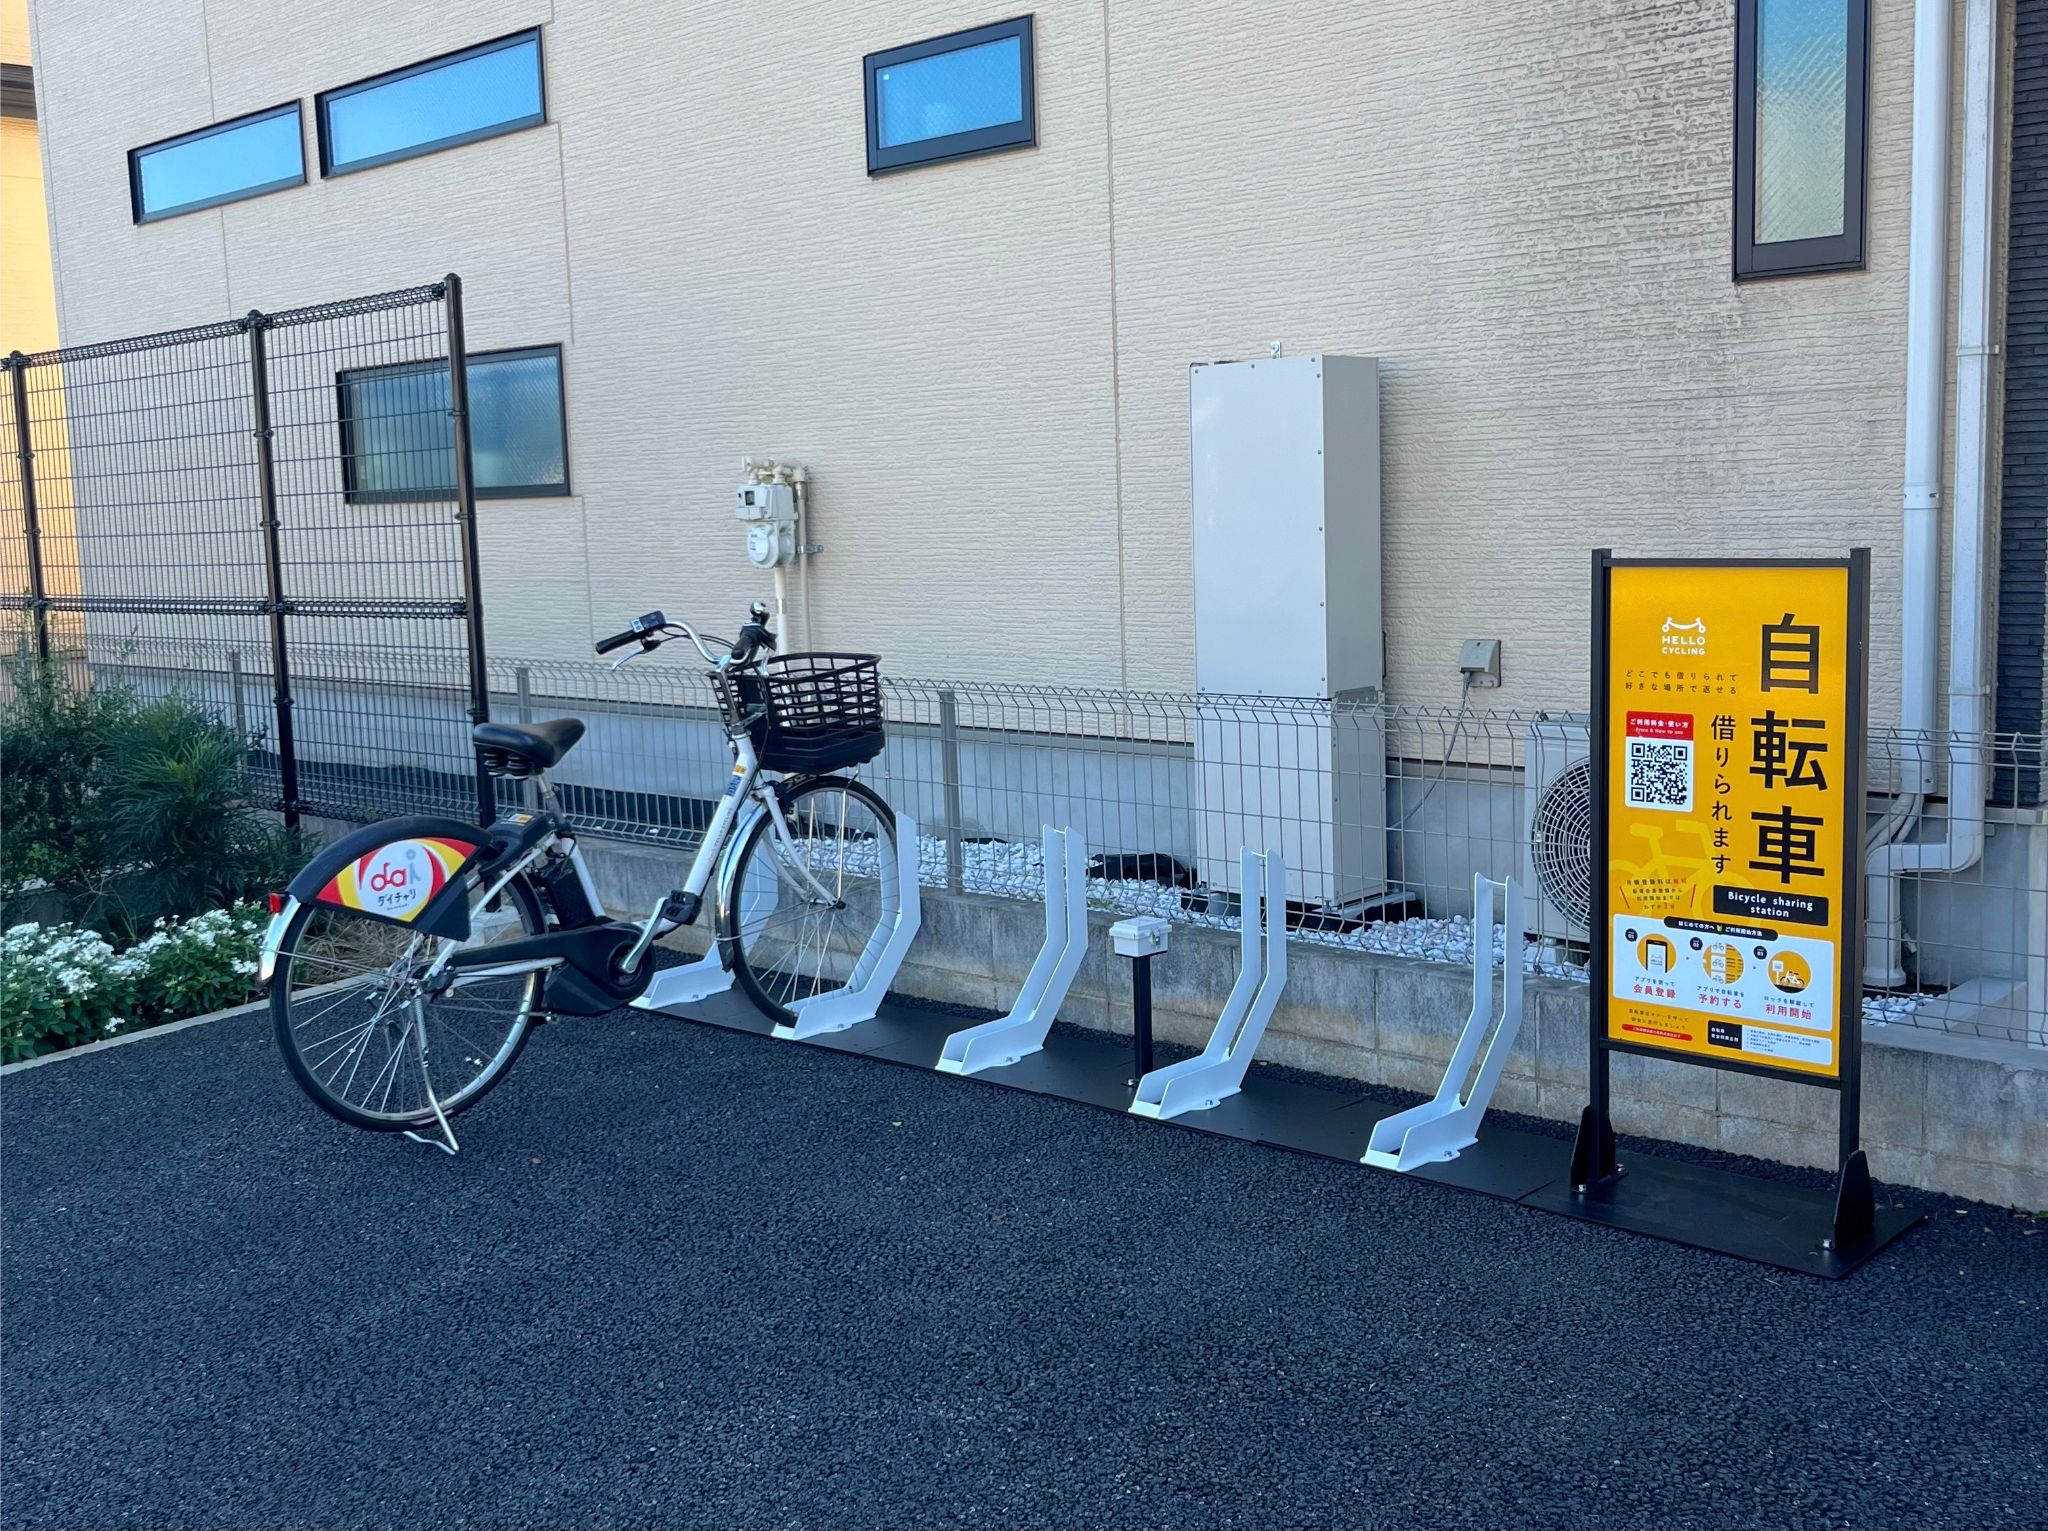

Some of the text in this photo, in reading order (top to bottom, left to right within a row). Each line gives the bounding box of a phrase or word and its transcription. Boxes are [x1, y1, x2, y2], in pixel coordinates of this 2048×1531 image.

[1662, 635, 1706, 646] HELLO
[1662, 647, 1706, 656] CYCLING
[1625, 670, 1737, 681] どこでも借りられて
[1625, 682, 1737, 695] 好きな場所で返せる
[1749, 613, 1828, 884] 自転車
[1711, 714, 1736, 874] 借りられます
[378, 889, 416, 907] ダイチャリ
[1728, 891, 1813, 911] Bicycle sharing
[1750, 906, 1789, 917] station
[1633, 984, 1676, 999] 会員登録
[1699, 993, 1742, 1009] 予約する
[1765, 1003, 1811, 1020] 利用開始
